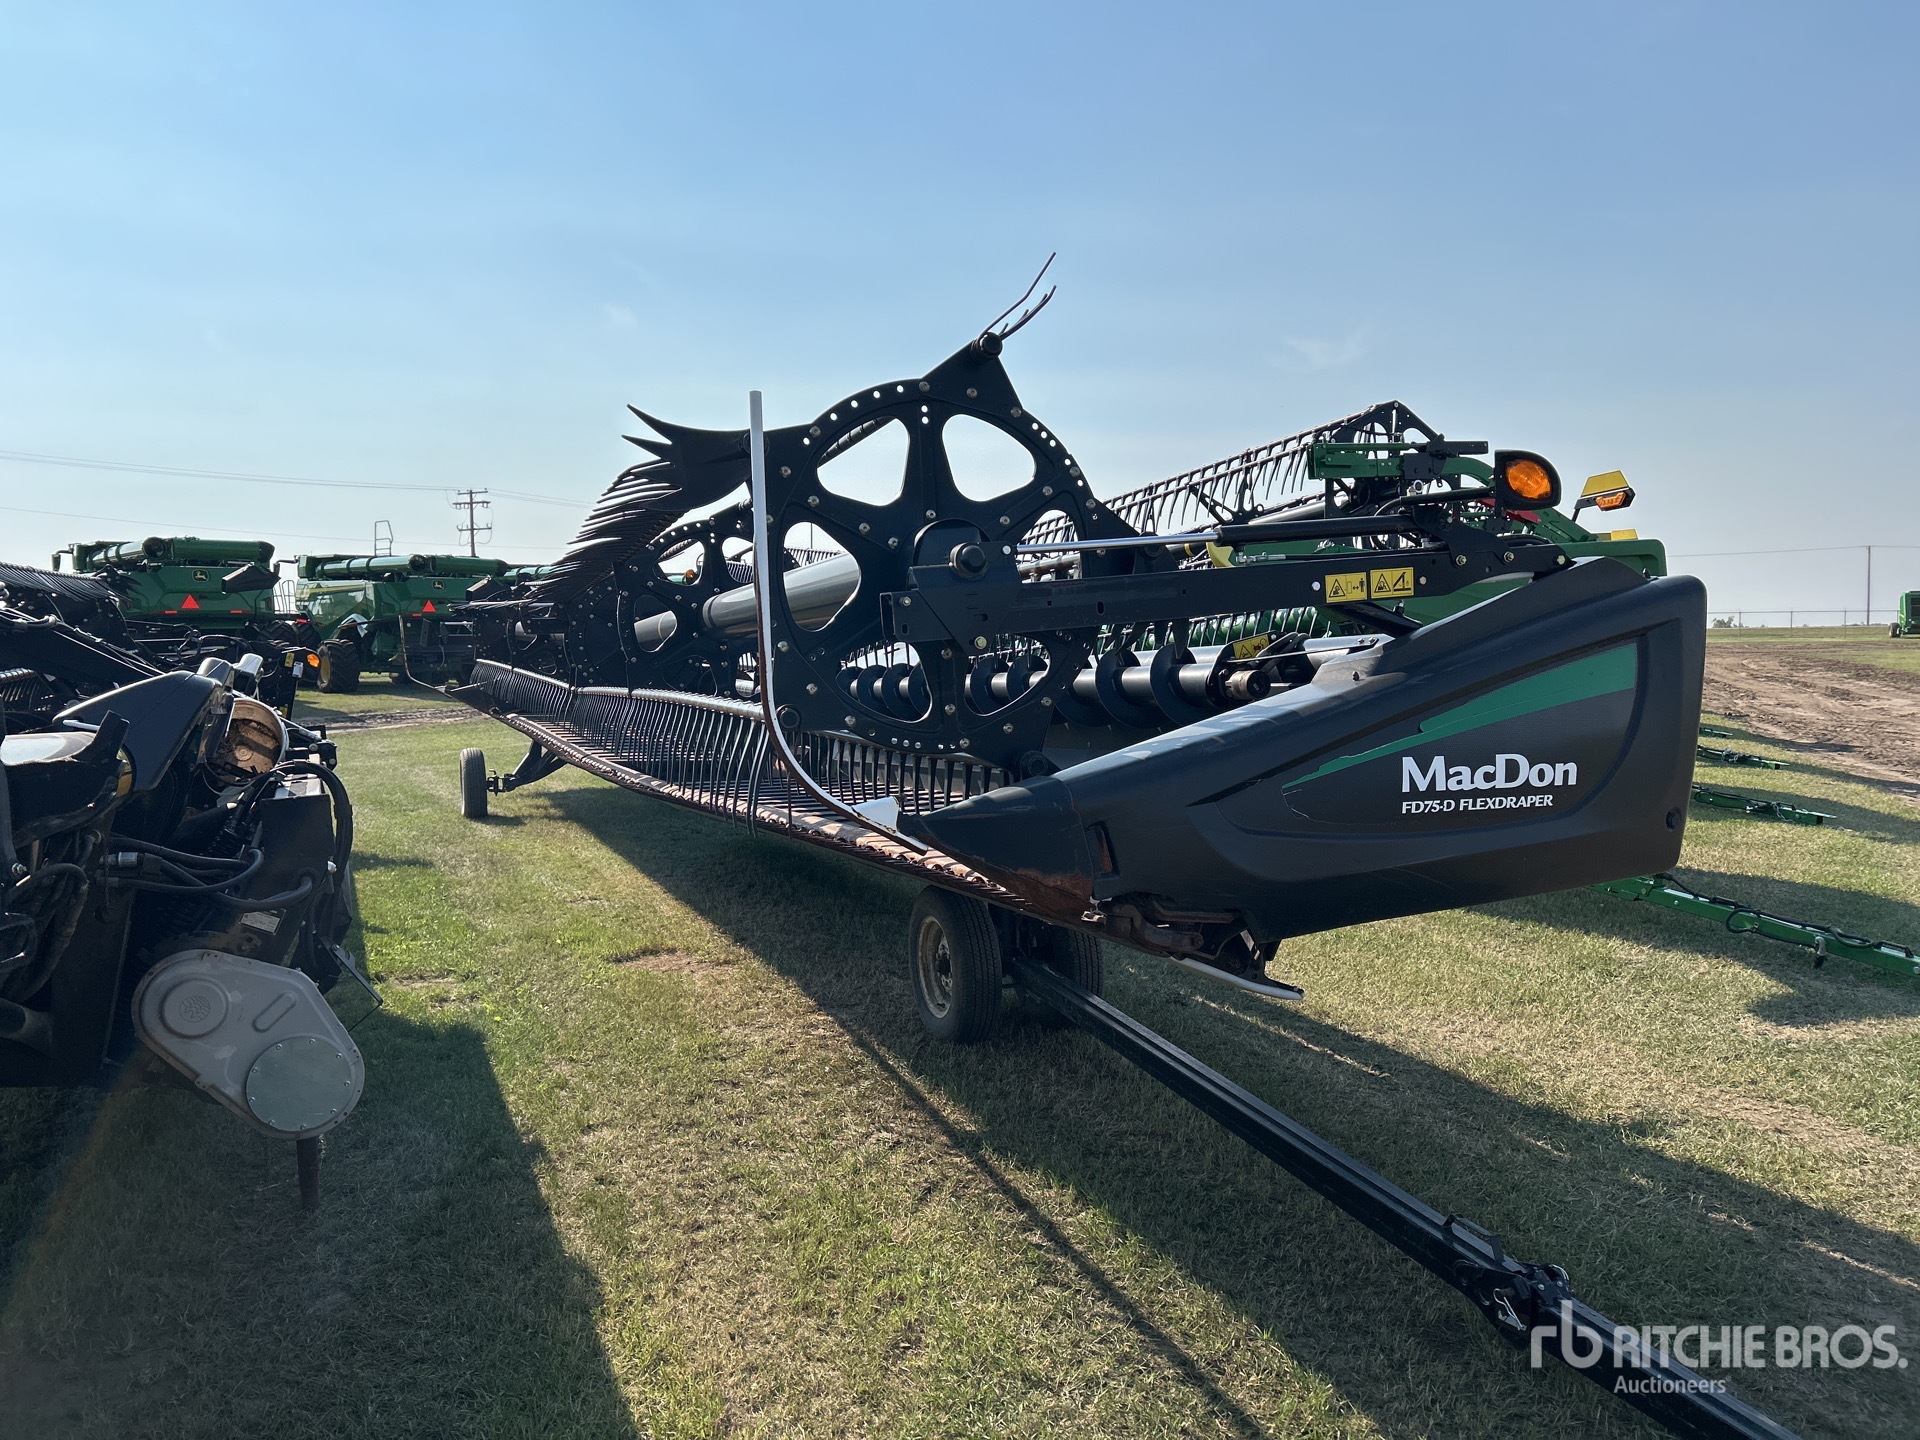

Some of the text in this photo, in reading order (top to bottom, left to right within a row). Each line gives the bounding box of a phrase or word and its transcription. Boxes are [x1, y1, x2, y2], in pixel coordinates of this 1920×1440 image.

[1401, 753, 1578, 793] MacDon
[1401, 794, 1553, 814] FD75-D FLEXDRAPER
